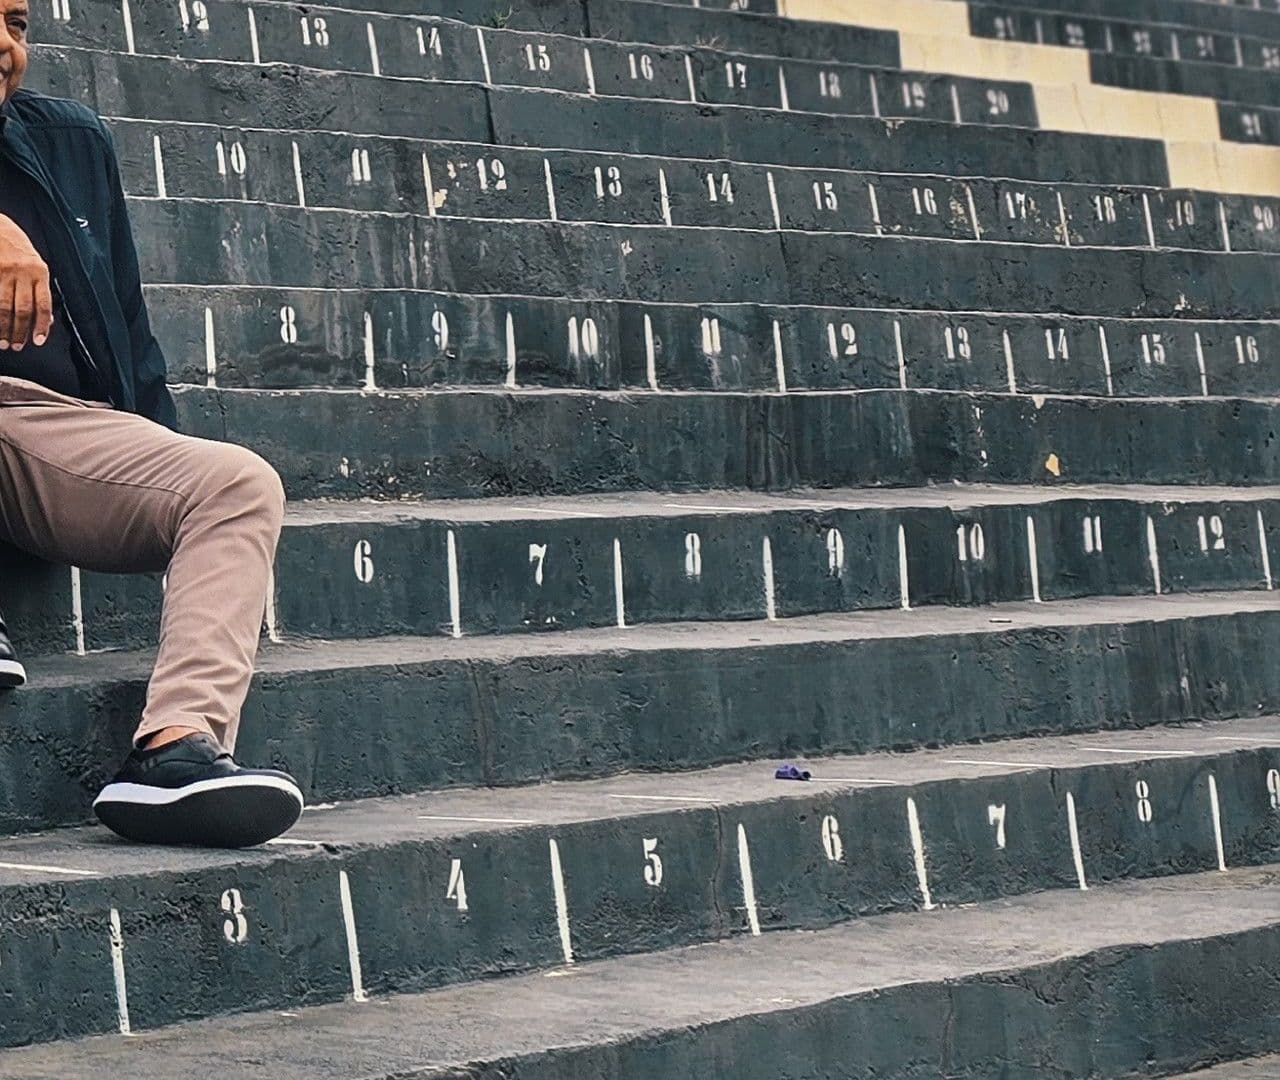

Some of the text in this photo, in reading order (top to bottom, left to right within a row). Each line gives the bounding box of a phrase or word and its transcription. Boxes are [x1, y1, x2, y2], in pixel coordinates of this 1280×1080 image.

[301, 18, 328, 45] 13
[417, 27, 441, 55] 14
[526, 44, 550, 70] 15
[629, 54, 653, 80] 16
[216, 142, 246, 175] 10
[352, 149, 371, 181] 11
[595, 167, 621, 198] 13
[707, 174, 733, 203] 14
[813, 183, 837, 210] 15
[913, 188, 936, 214] 16
[281, 307, 296, 343] 8
[432, 311, 448, 349] 9
[568, 317, 598, 357] 10
[701, 318, 721, 355] 11
[828, 324, 857, 358] 12
[945, 327, 970, 359] 13
[1046, 329, 1068, 359] 14
[1141, 334, 1165, 363] 15
[1235, 336, 1258, 363] 16
[355, 541, 373, 582] 6
[530, 544, 546, 584] 7
[957, 524, 984, 560] 10
[1084, 517, 1102, 552] 11
[1198, 516, 1224, 551] 12
[447, 859, 468, 910] 4
[643, 838, 662, 886] 5
[822, 816, 842, 861] 6
[988, 805, 1005, 848] 7
[1136, 781, 1151, 821] 8
